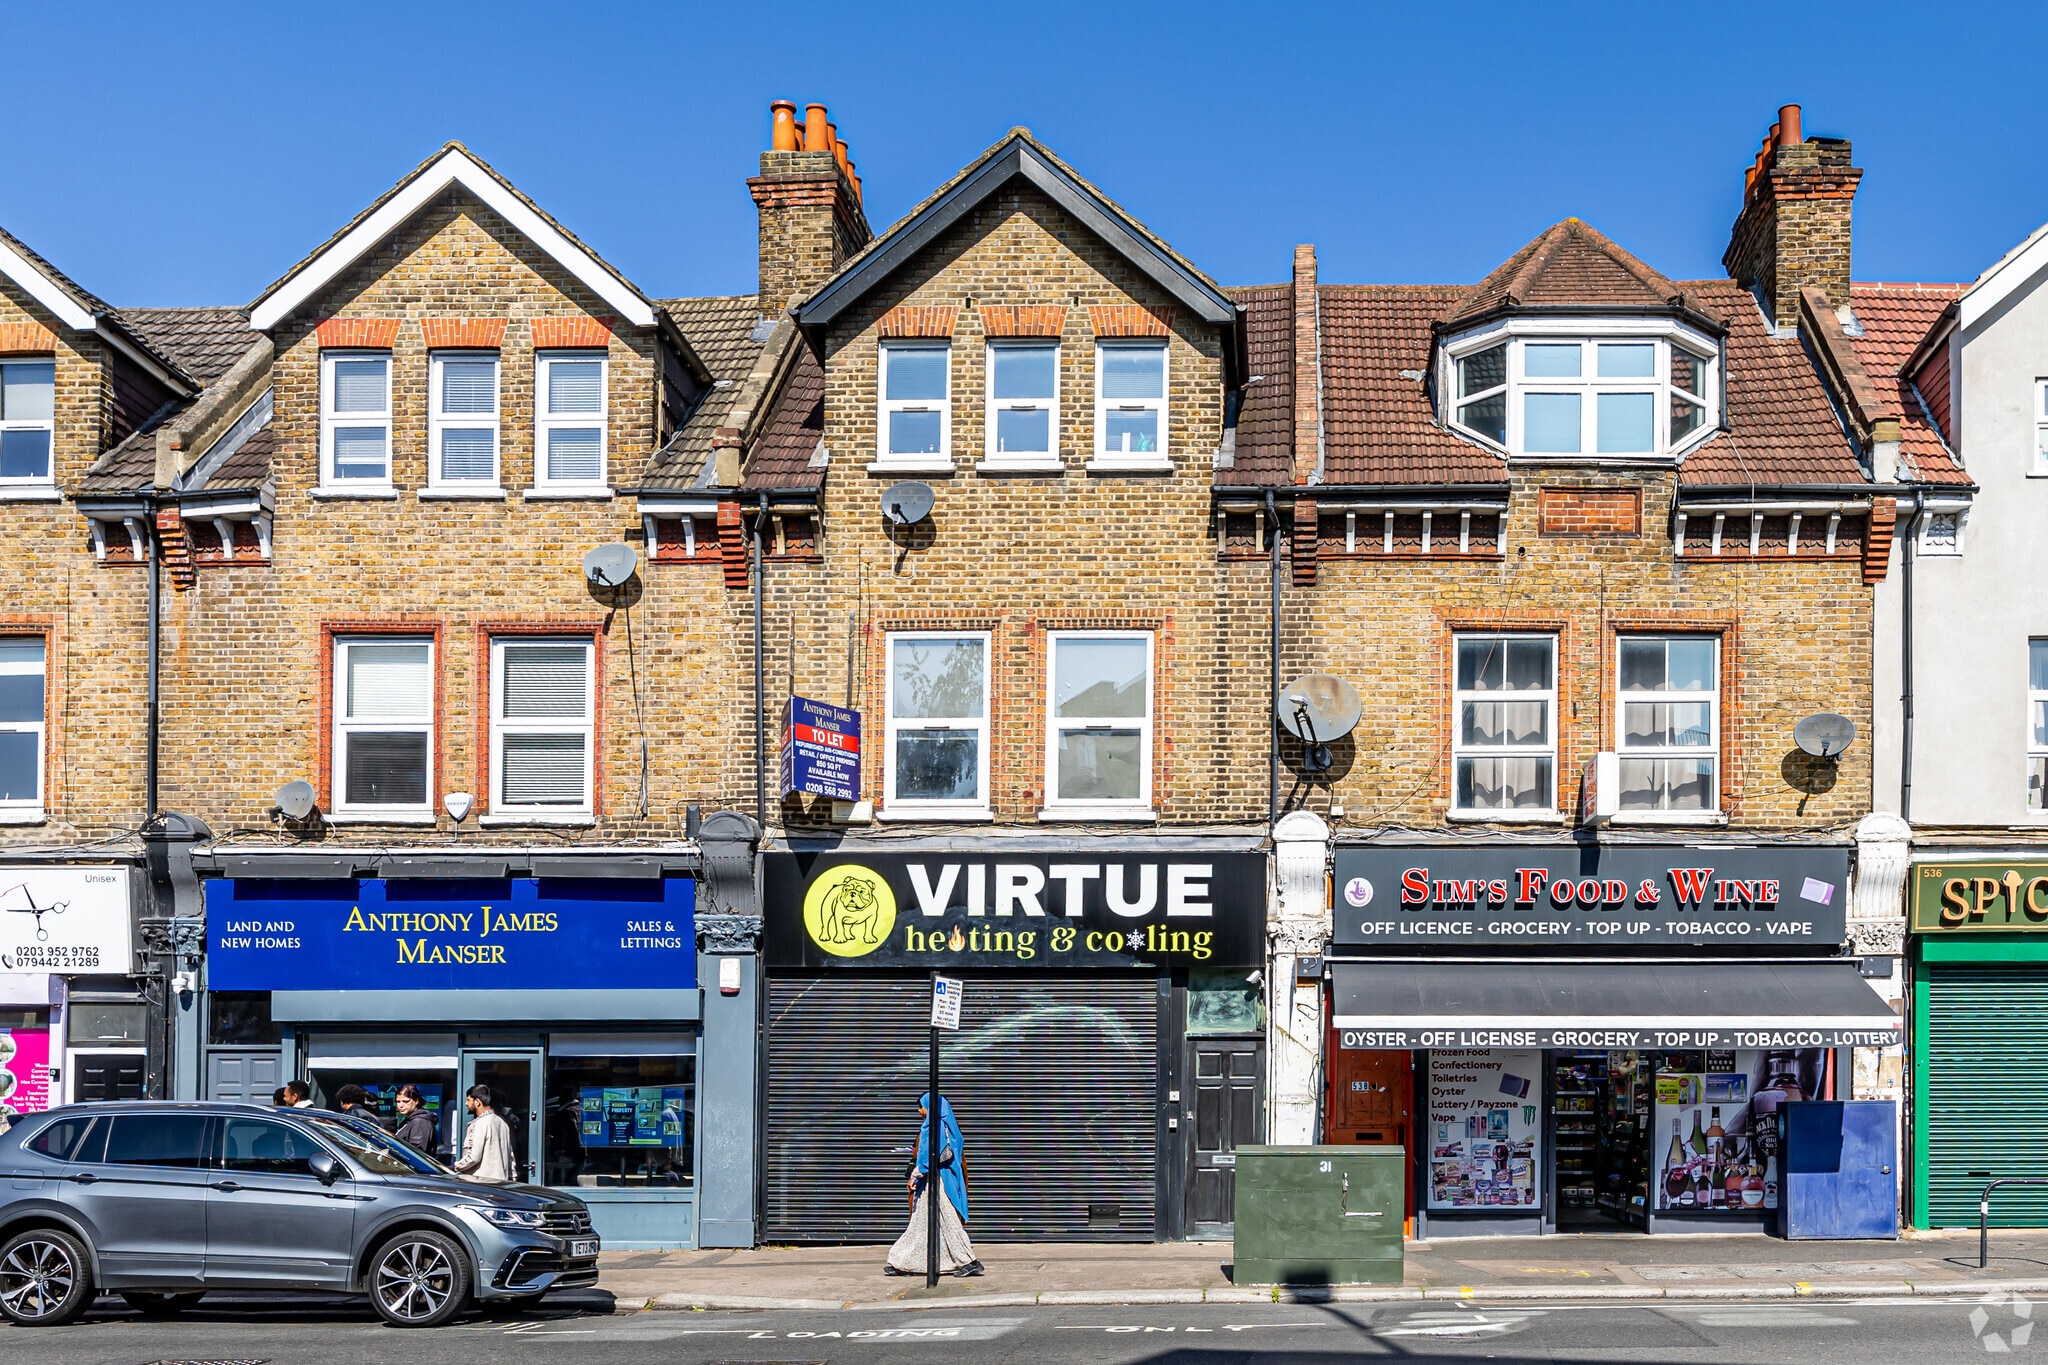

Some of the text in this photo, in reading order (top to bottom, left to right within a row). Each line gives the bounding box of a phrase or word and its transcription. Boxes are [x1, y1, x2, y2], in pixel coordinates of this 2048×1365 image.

[803, 701, 851, 722] ANTHONY JAMES
[815, 716, 841, 732] MANSER
[811, 729, 844, 747] TO LET
[807, 767, 837, 779] AVAILABLE
[837, 772, 850, 781] NOW
[805, 782, 824, 794] 0208
[85, 874, 117, 884] Unisex
[1923, 868, 1943, 878] 536
[905, 863, 1214, 917] VIRTUE
[1401, 867, 1508, 904] SIM'S
[1515, 867, 1629, 904] FOOD
[1637, 878, 1661, 904] &
[1667, 867, 1781, 904] WINE
[226, 921, 295, 932] LAND AND
[342, 906, 559, 938] ANTHONY JAMES
[627, 920, 675, 932] SALES &
[1360, 921, 1396, 935] OFF
[1400, 921, 1473, 935] LICENCE
[1488, 921, 1572, 935] GROCERY
[1586, 921, 1622, 935] TOP
[1626, 921, 1651, 935] UP
[1666, 921, 1751, 935] TOBACCO
[1766, 921, 1813, 935] VAPE
[221, 938, 301, 949] NEW HOMES
[620, 937, 681, 949] LETTINGS
[905, 924, 1214, 960] heting & coling
[16, 947, 99, 957] 0203 952 9762
[396, 938, 506, 964] MANSER
[17, 957, 99, 967] 079442 21289
[1344, 1031, 1408, 1046] OYSTER
[1420, 1031, 1456, 1046] OFF
[1460, 1031, 1537, 1046] LICENSE
[1551, 1031, 1640, 1047] GROCERY
[1654, 1032, 1690, 1047] TOP
[1694, 1032, 1719, 1047] UP
[1733, 1031, 1823, 1047] TOBACCO
[1833, 1031, 1899, 1045] LOTTERY
[1431, 1061, 1503, 1071] Confectionery
[1431, 1074, 1478, 1083] Toiletries
[1352, 1082, 1368, 1090] 538
[1431, 1087, 1466, 1096] Oyster
[1431, 1100, 1469, 1110] Lottery
[1477, 1101, 1519, 1110] Payzone
[1431, 1114, 1456, 1123] Vape
[1319, 1160, 1332, 1173] 31
[747, 1329, 961, 1339] LOADING
